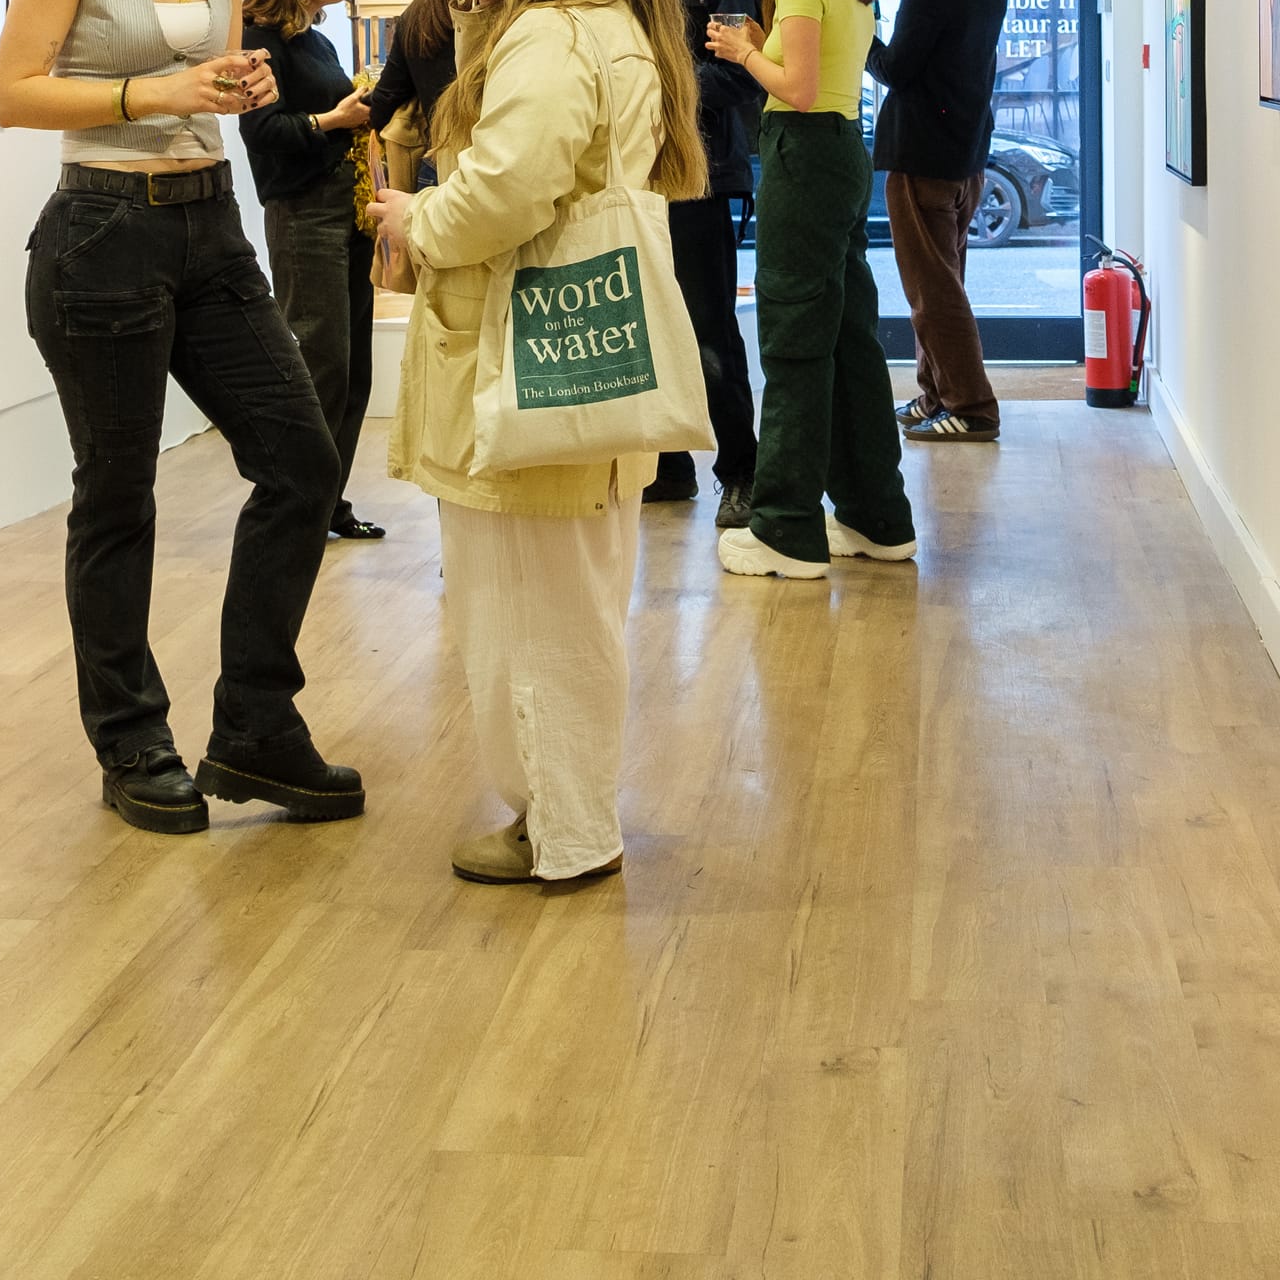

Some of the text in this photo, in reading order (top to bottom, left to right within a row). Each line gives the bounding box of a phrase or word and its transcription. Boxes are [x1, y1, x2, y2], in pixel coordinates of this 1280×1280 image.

[1005, 39, 1047, 58] LET
[517, 255, 633, 316] word
[544, 315, 585, 332] on the
[526, 321, 638, 365] water
[521, 371, 650, 400] The London Bookbarge
